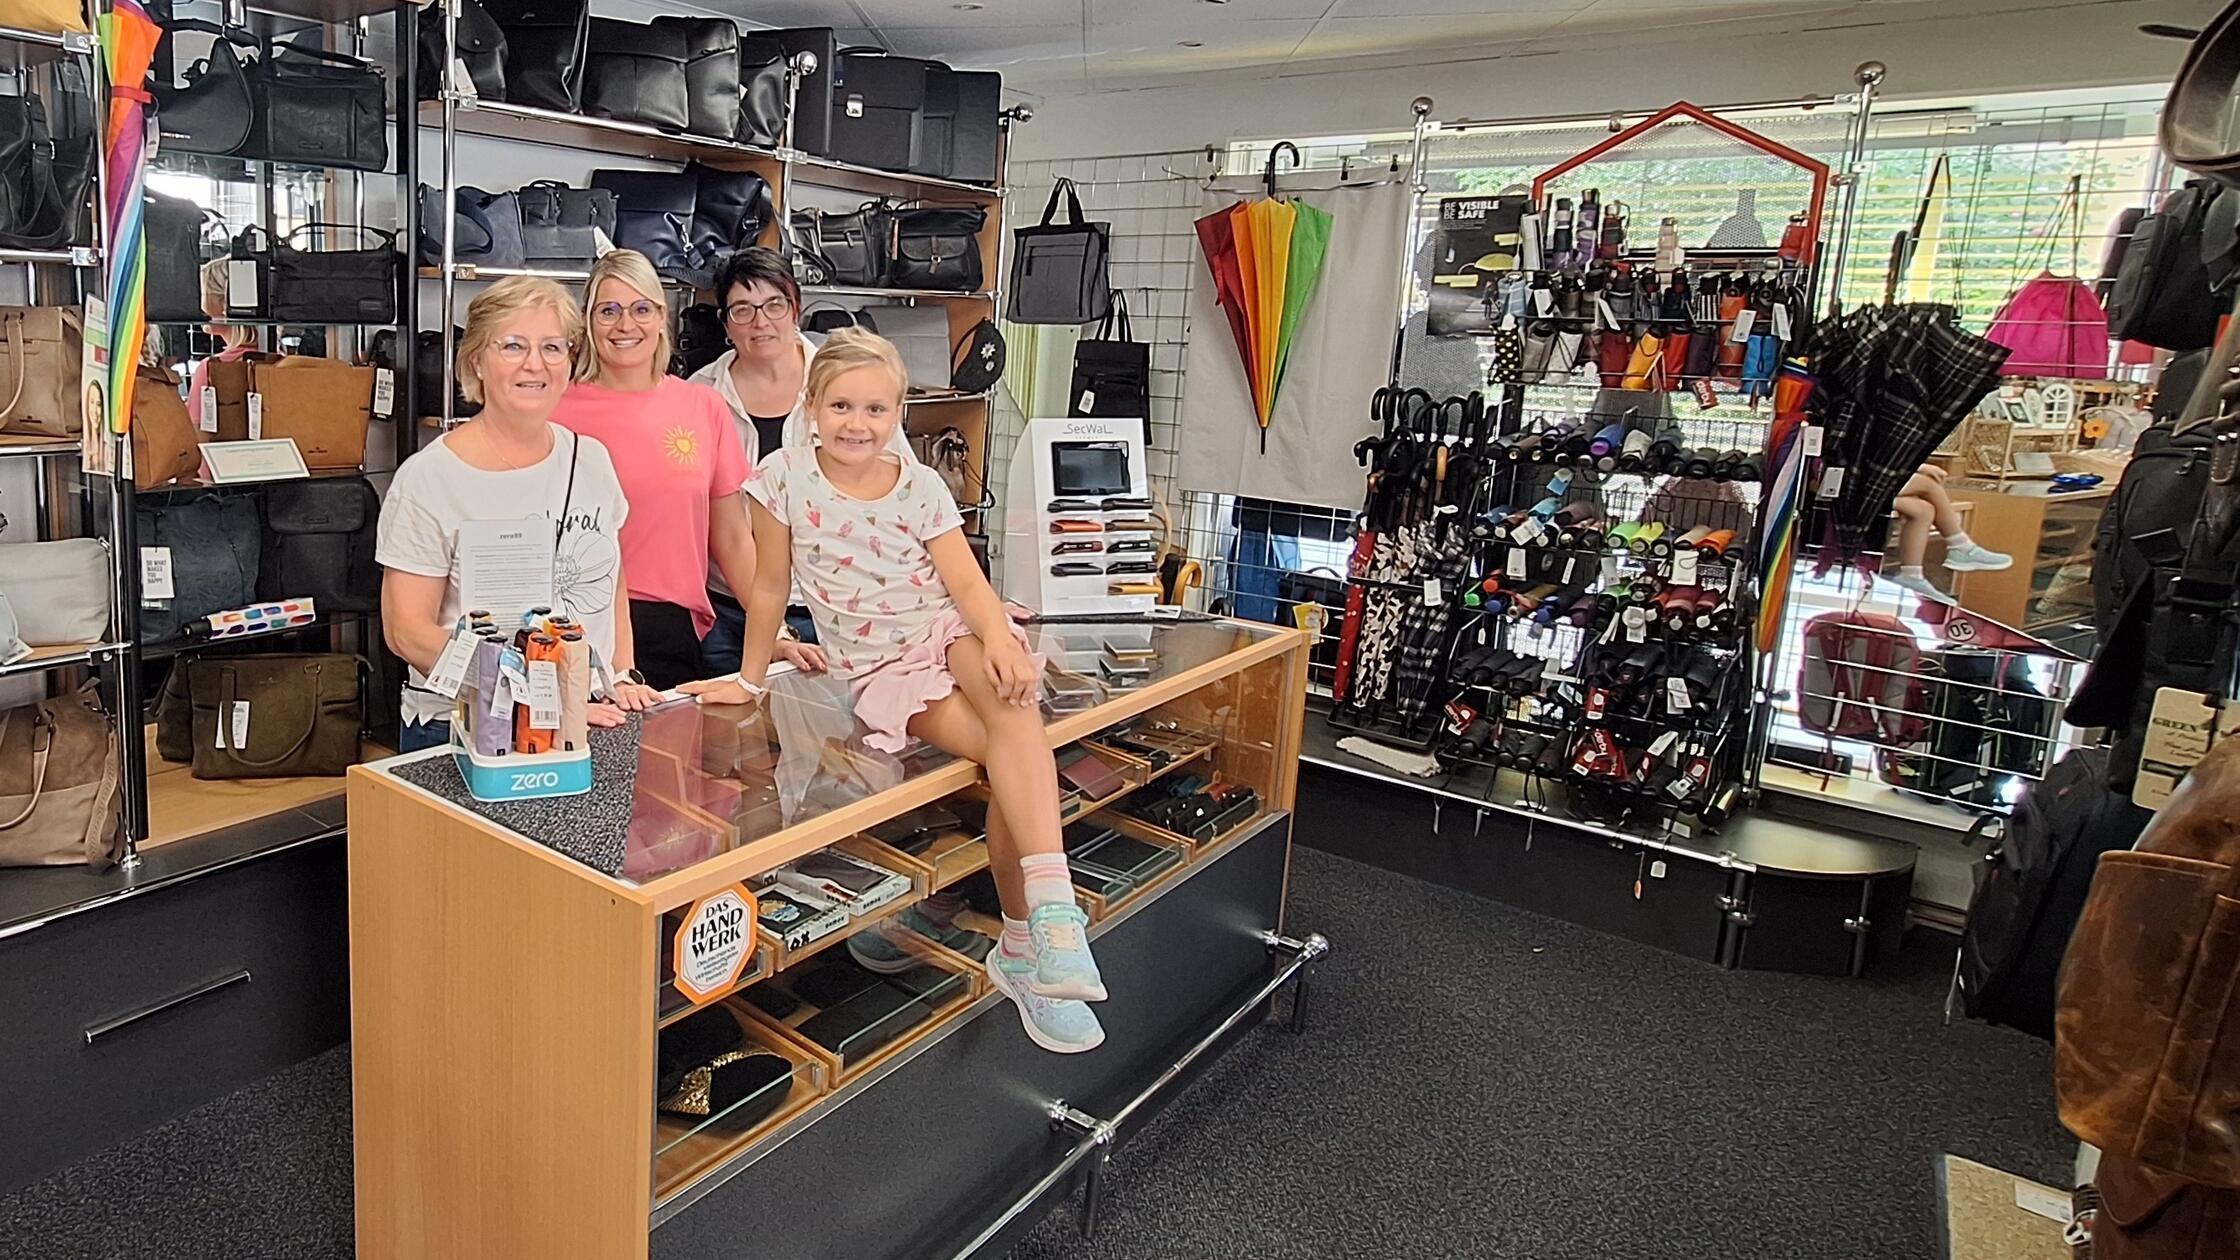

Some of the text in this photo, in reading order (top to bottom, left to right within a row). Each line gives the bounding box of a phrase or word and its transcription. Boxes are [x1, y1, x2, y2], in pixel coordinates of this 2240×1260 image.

[1443, 210, 1486, 219] BE SAFE
[1444, 200, 1500, 210] BE VISIBLE
[510, 771, 559, 791] zero
[706, 899, 729, 919] DAS
[692, 907, 743, 943] HAND
[691, 923, 742, 960] WERK
